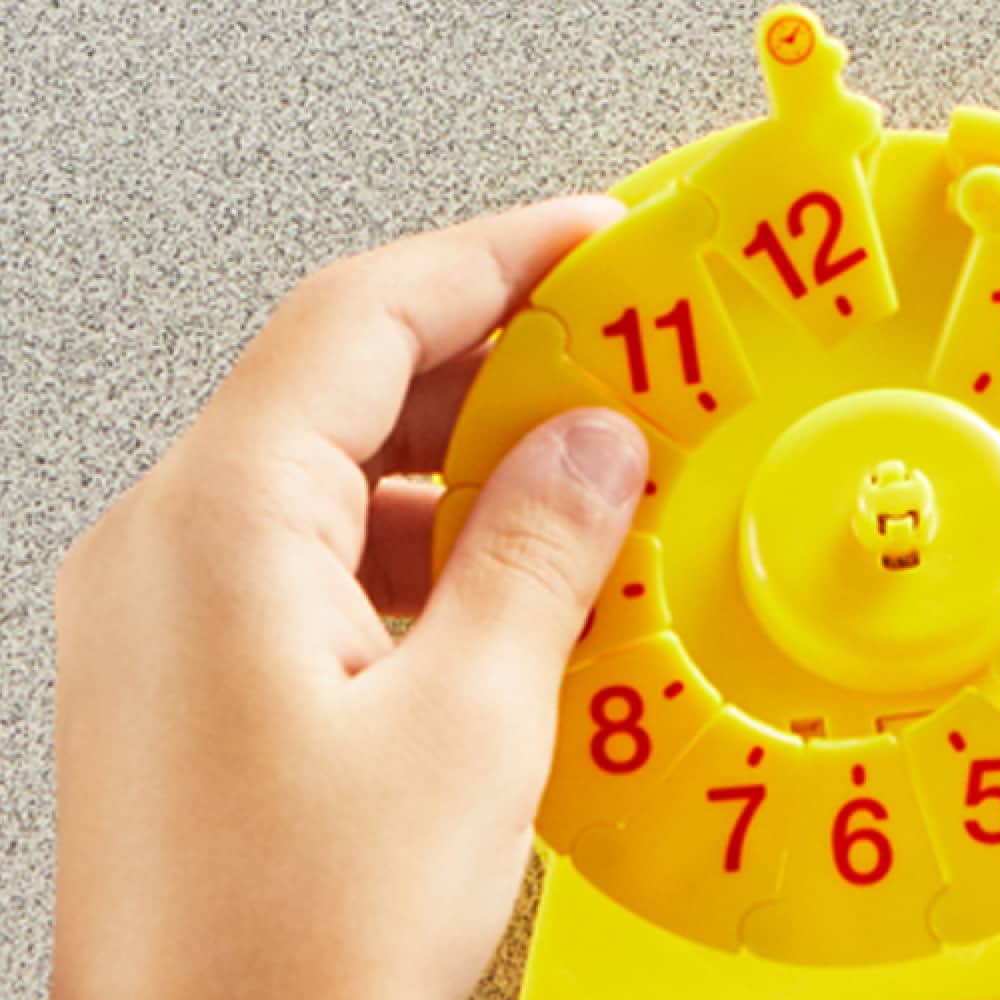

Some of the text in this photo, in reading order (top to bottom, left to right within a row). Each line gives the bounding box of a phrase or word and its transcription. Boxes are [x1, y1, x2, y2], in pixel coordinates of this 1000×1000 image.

[743, 191, 868, 299] 12
[602, 299, 703, 395] 11
[588, 684, 652, 776] 8
[706, 783, 767, 873] 7
[831, 797, 893, 887] 6
